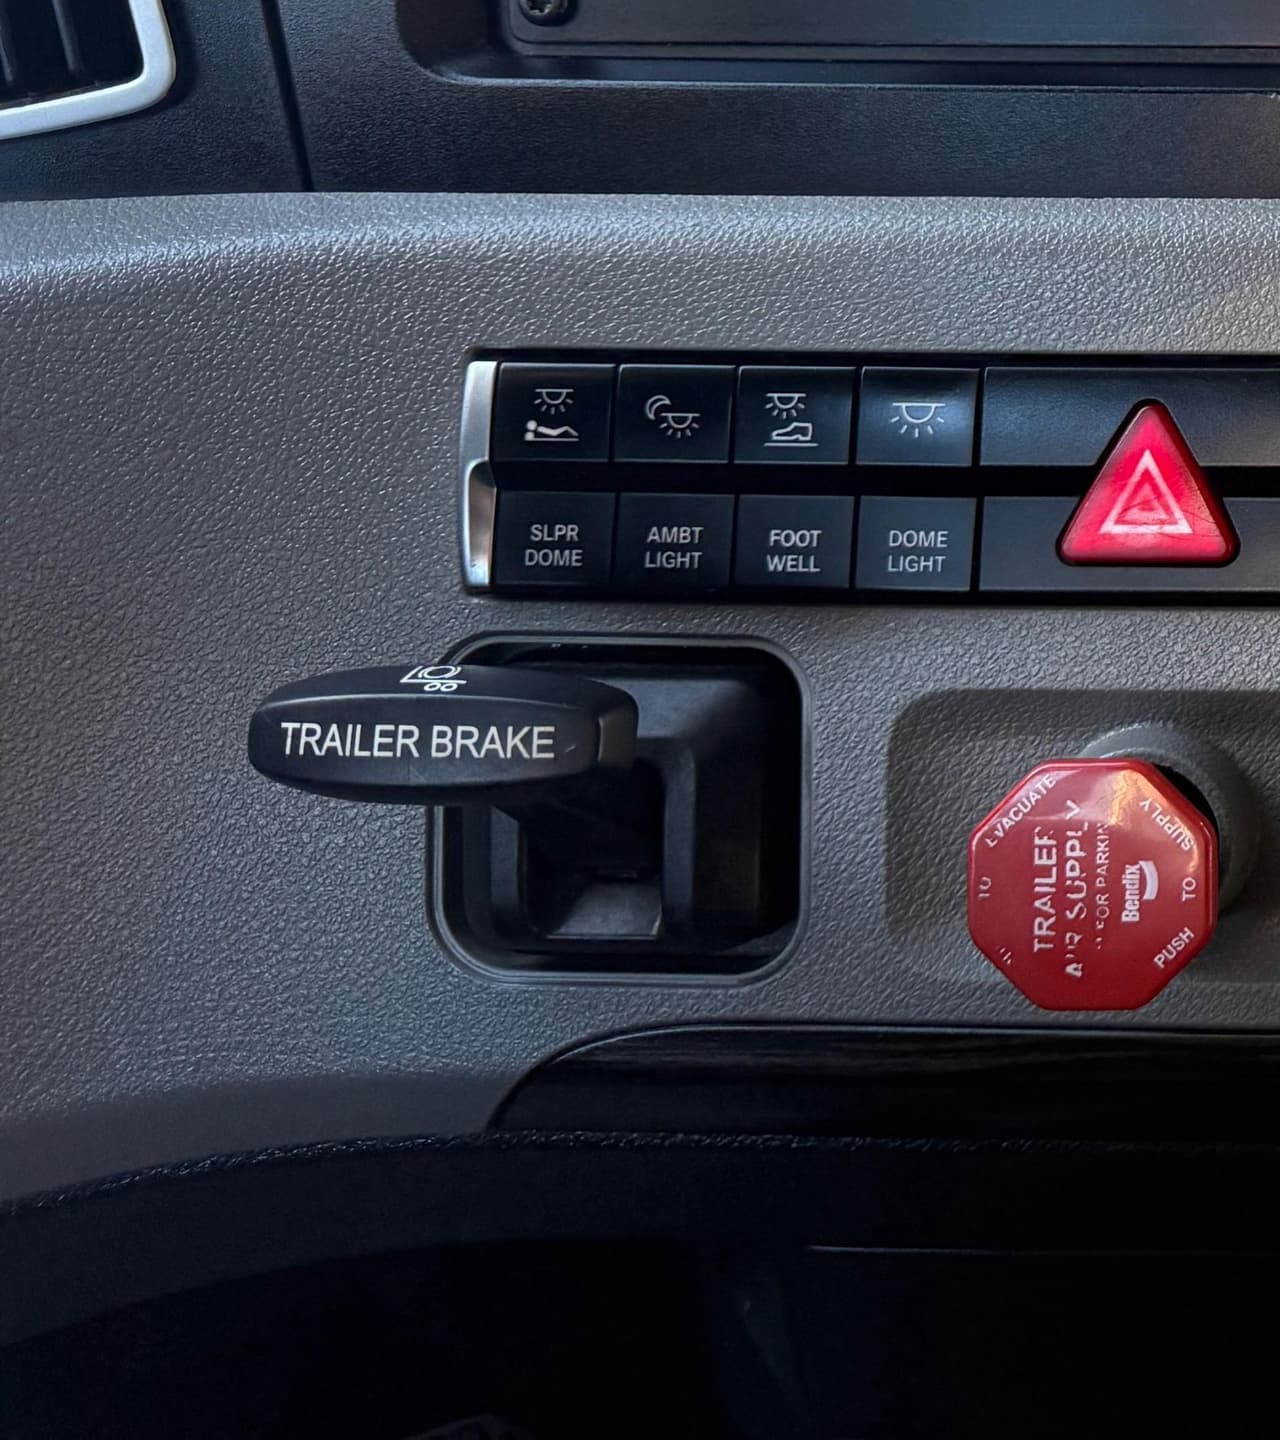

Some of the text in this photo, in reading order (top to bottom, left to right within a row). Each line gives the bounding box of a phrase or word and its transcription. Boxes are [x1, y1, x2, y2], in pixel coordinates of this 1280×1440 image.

[530, 524, 579, 542] SLPR
[646, 526, 704, 544] AMBT
[768, 529, 822, 547] FOOT
[888, 530, 949, 548] DOME
[524, 549, 583, 567] DOME
[644, 551, 702, 570] LIGHT
[766, 555, 821, 573] WELL
[887, 555, 947, 573] LIGHT
[280, 721, 556, 759] TRAILER BRAKE
[1139, 797, 1197, 970] PUSH TO SUPPLY
[1120, 863, 1141, 923] Bendix
